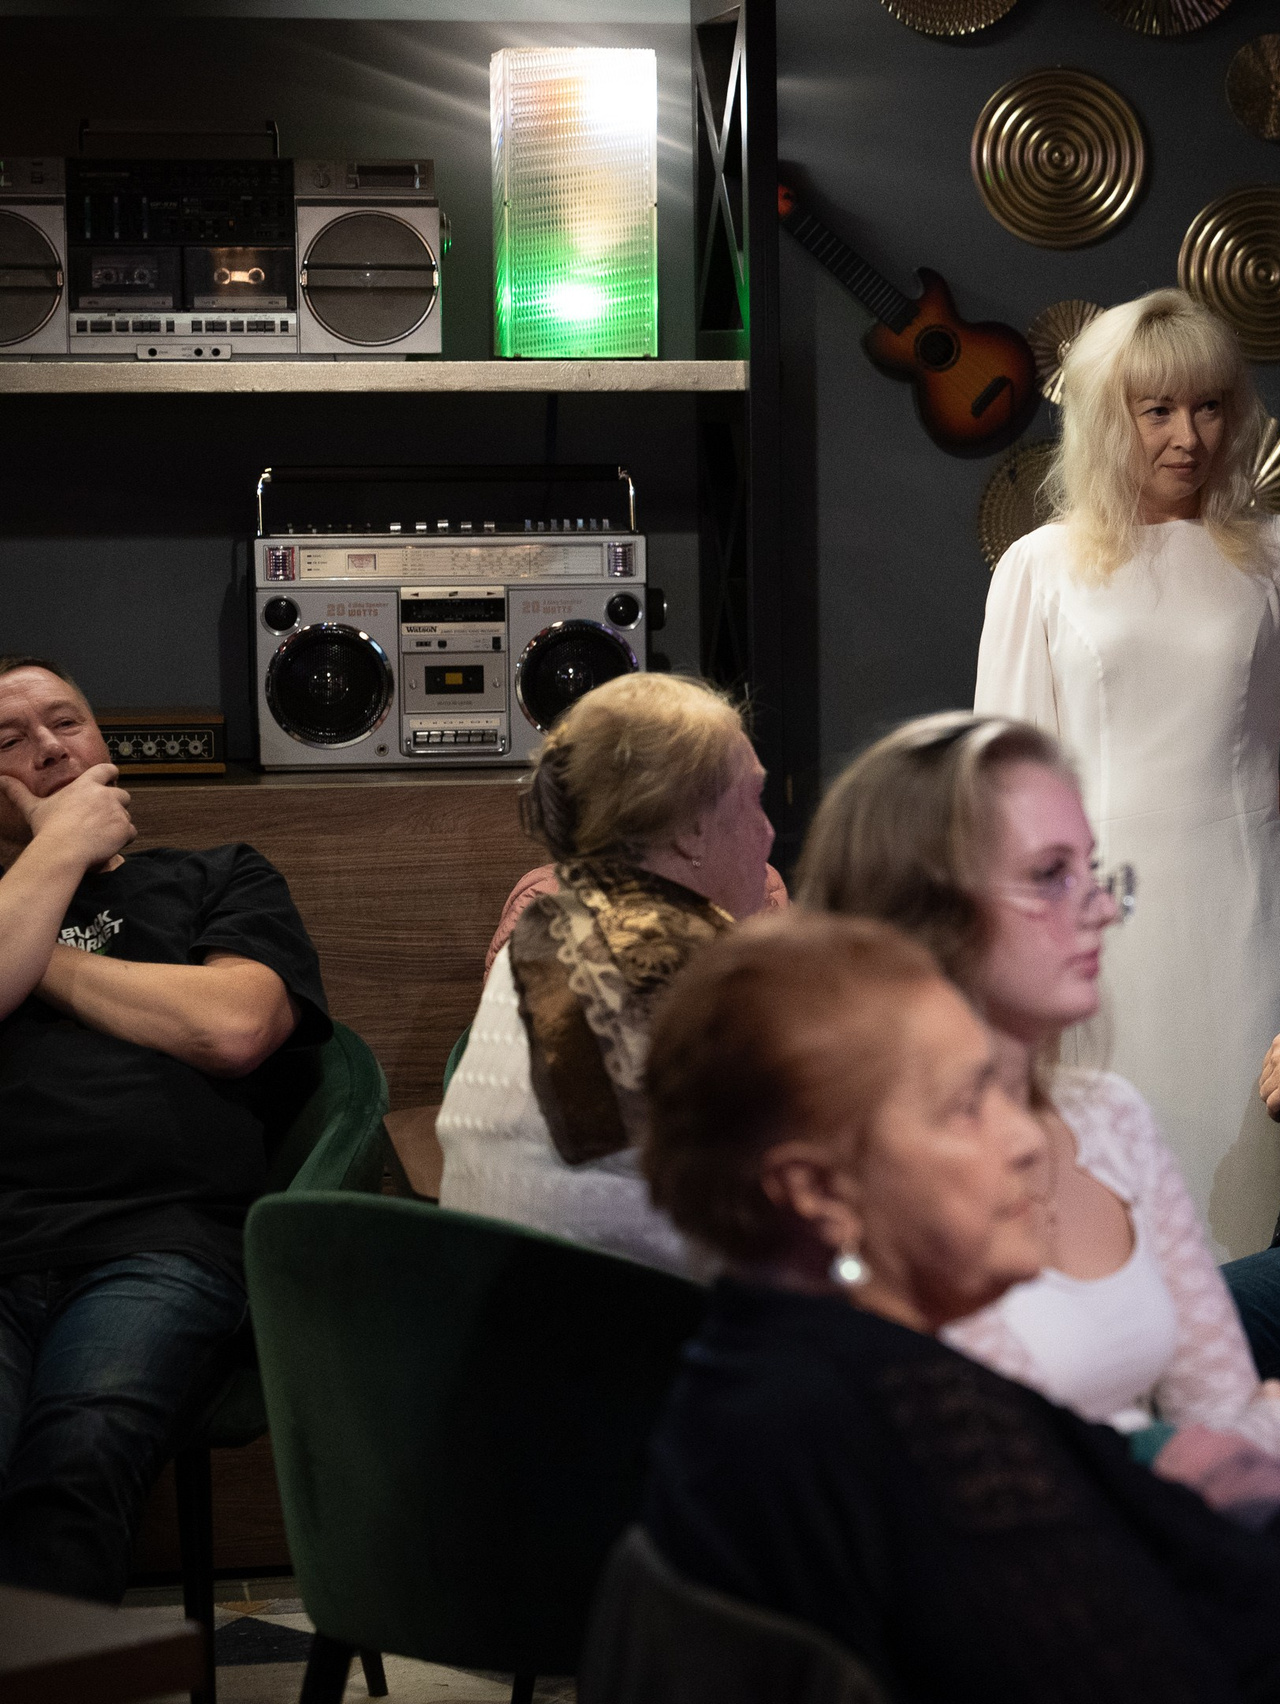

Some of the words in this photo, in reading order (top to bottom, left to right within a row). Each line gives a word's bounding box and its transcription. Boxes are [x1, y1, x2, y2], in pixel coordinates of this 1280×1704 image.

[326, 603, 345, 617] 20
[522, 600, 540, 614] 20
[61, 909, 113, 939] BLACK
